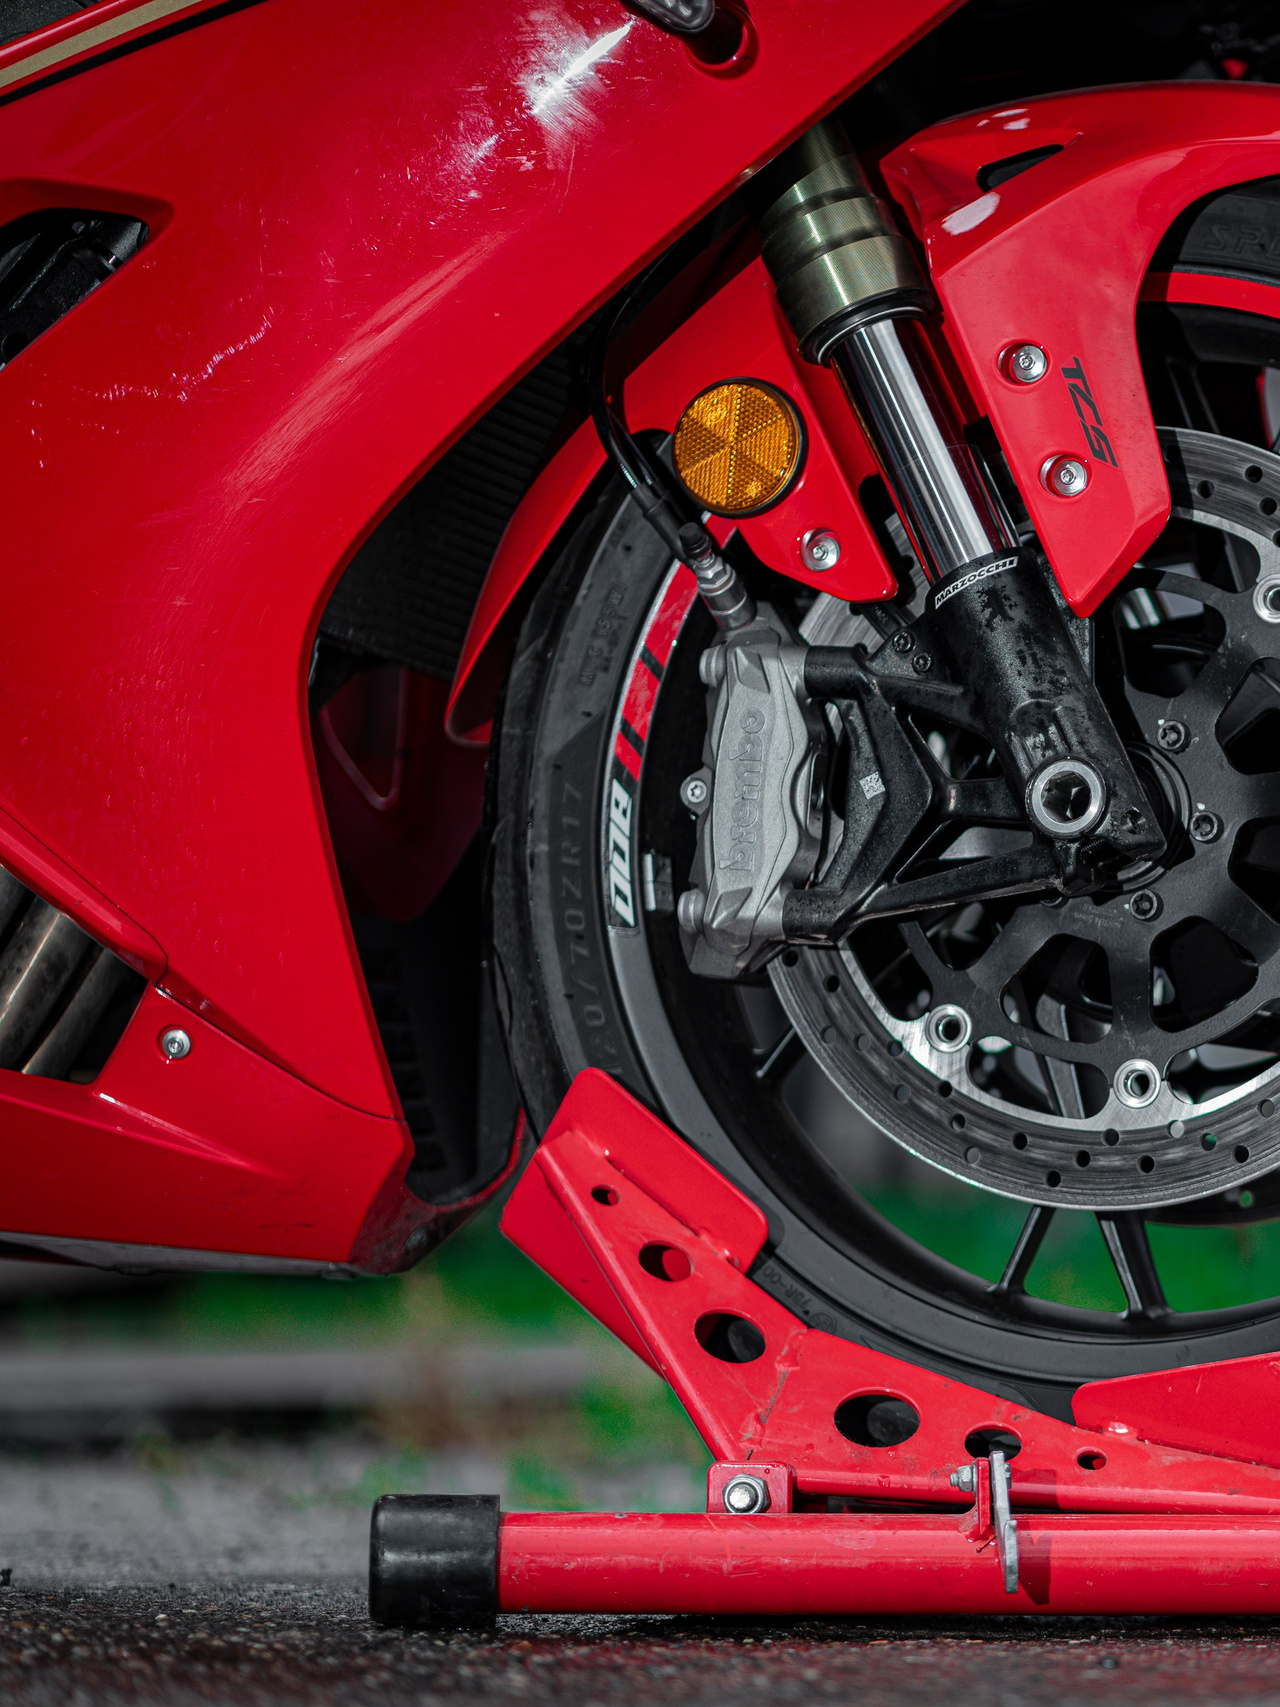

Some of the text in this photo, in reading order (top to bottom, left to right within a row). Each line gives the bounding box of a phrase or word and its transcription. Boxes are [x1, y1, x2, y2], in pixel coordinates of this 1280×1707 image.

[1059, 354, 1119, 468] TCS
[936, 557, 1016, 606] MARZOCCHI
[718, 705, 767, 873] brembo
